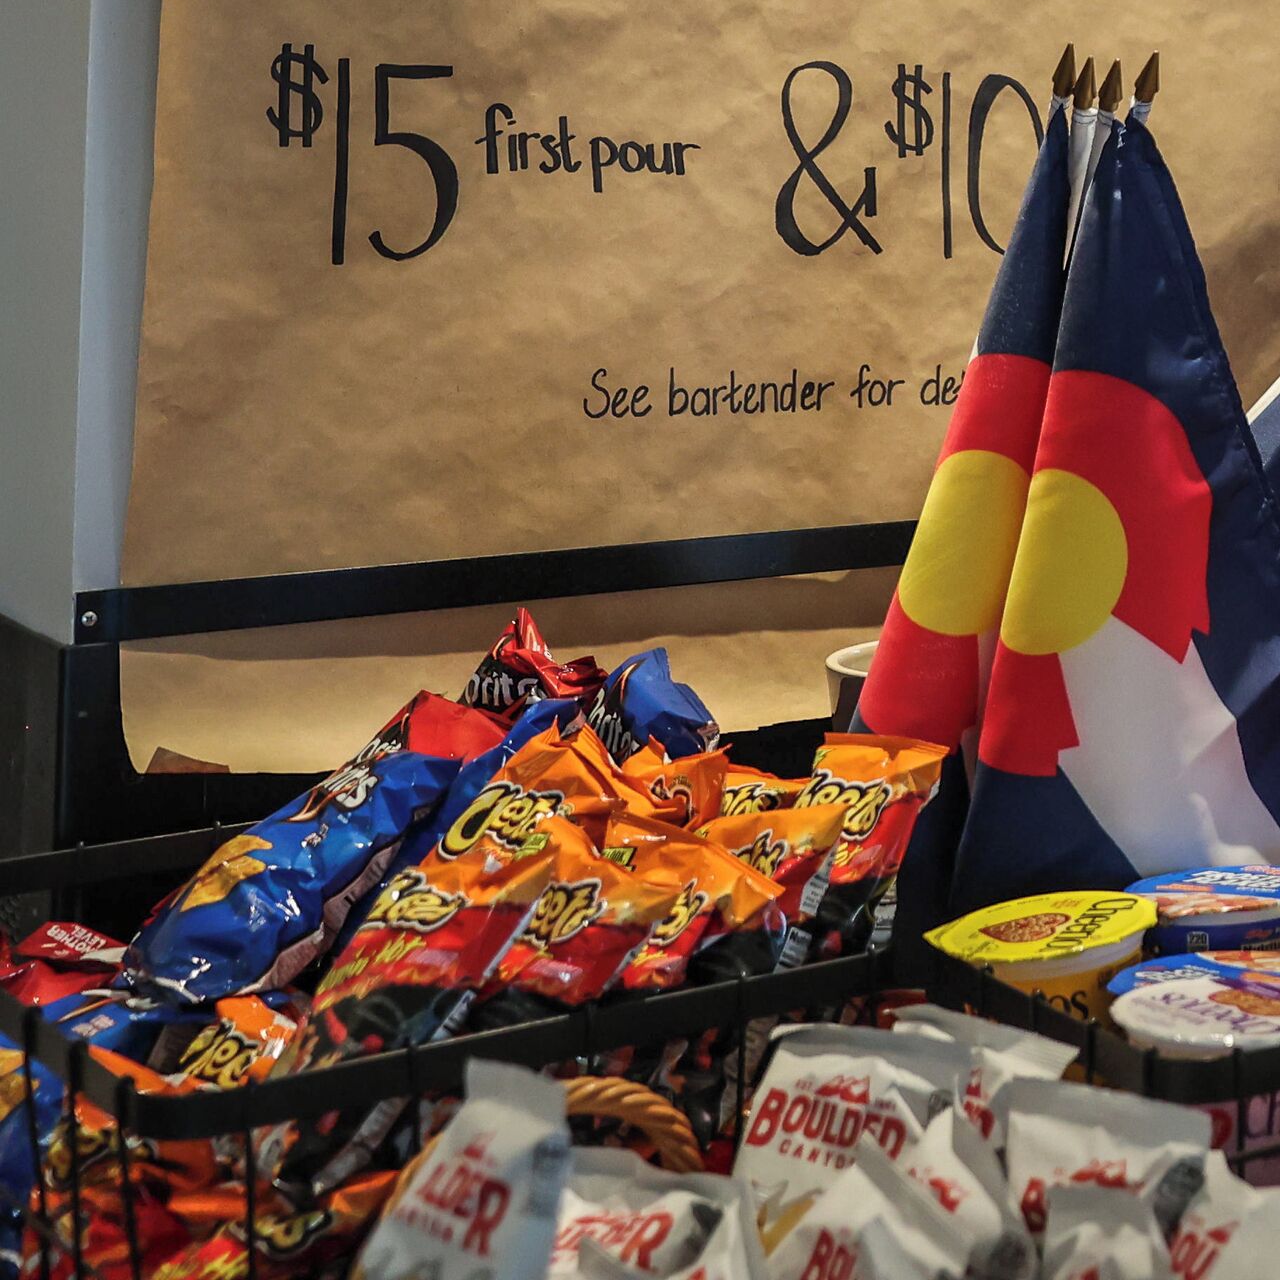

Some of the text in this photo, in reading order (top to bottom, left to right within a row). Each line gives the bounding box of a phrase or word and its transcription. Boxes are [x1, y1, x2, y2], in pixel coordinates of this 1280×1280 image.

[266, 43, 459, 265] $15
[590, 135, 701, 193] pour
[583, 368, 651, 420] See
[667, 365, 834, 417] bartender
[850, 364, 905, 408] for
[46, 925, 103, 954] NOTHER
